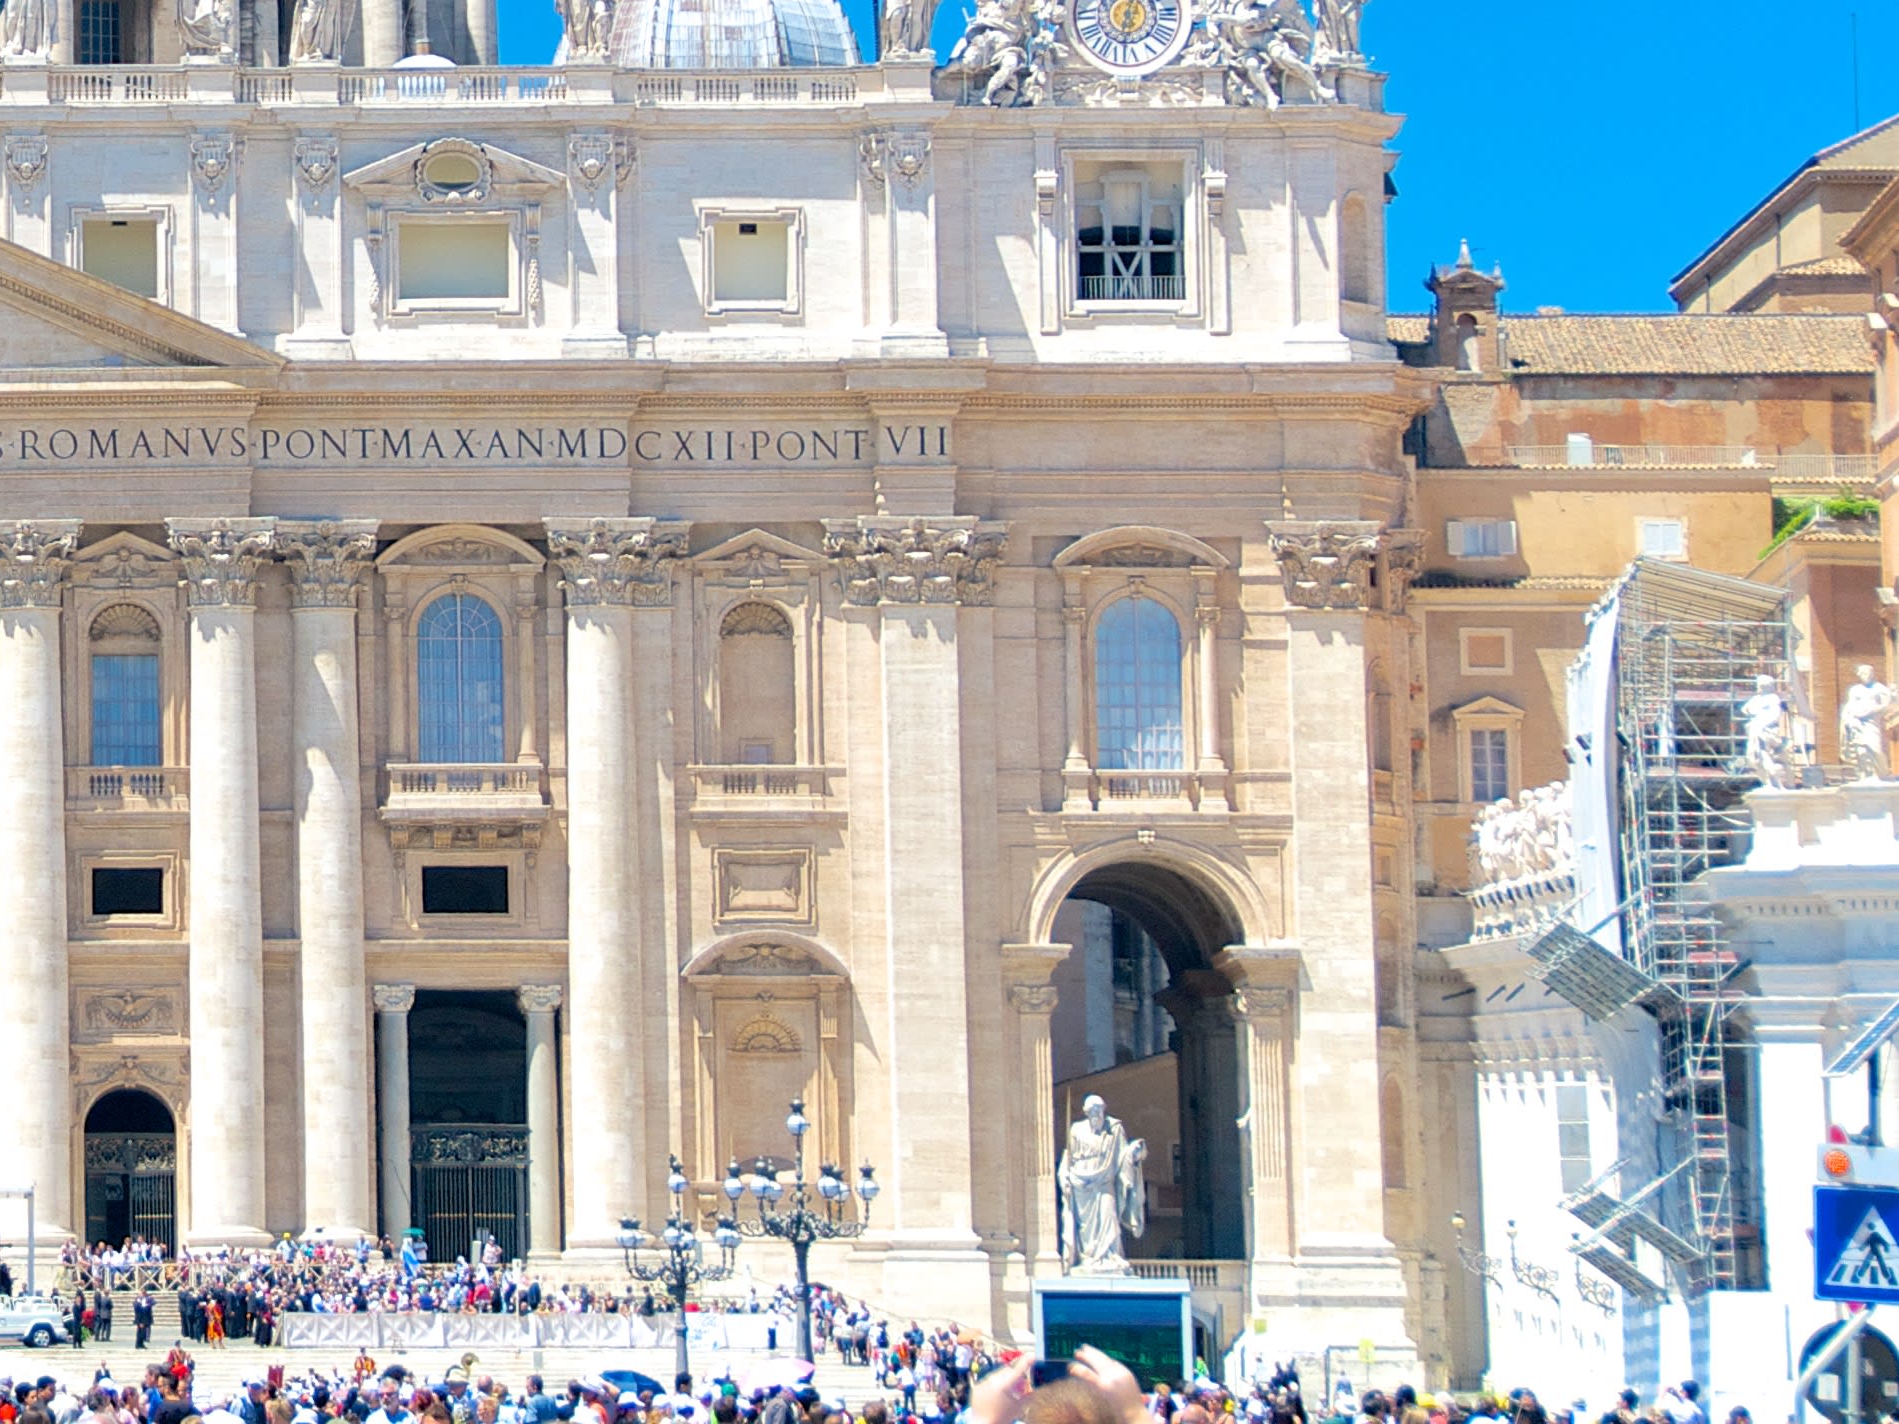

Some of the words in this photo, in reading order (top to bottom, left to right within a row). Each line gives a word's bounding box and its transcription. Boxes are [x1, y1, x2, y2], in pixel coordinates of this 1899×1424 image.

[18, 427, 248, 461] ROMANVS
[260, 428, 375, 461] PONT
[379, 428, 476, 460] MAX
[488, 428, 545, 460] AN
[751, 429, 869, 461] PONT
[886, 425, 949, 457] VII
